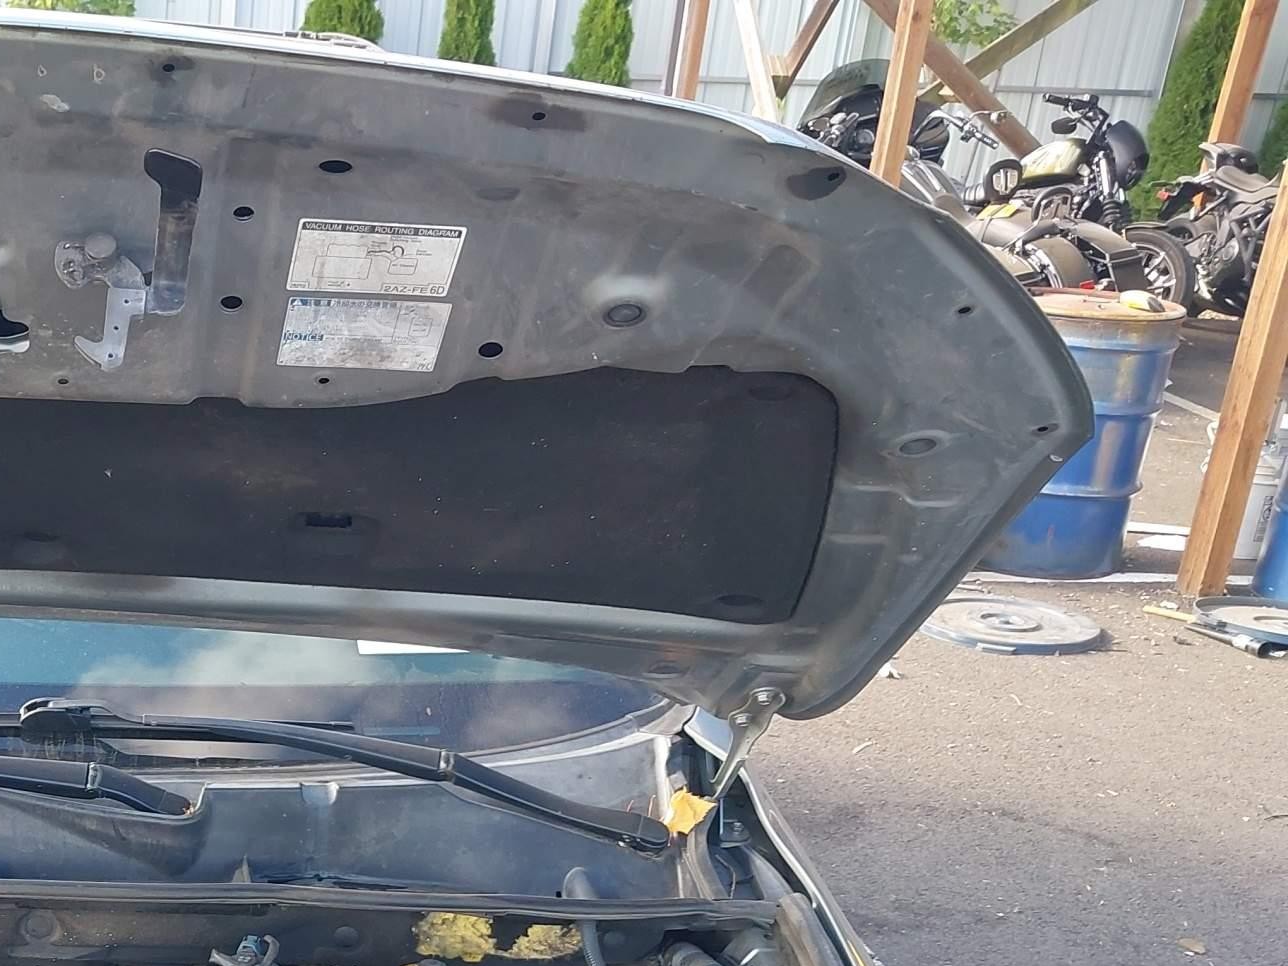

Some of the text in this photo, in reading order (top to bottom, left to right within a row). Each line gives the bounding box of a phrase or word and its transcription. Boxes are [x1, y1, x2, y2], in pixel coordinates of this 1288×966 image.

[305, 222, 460, 238] VACUUM HOSE ROUTING DIAGRAM
[383, 285, 428, 294] 2AZ-FE
[285, 332, 323, 341] NOTICE
